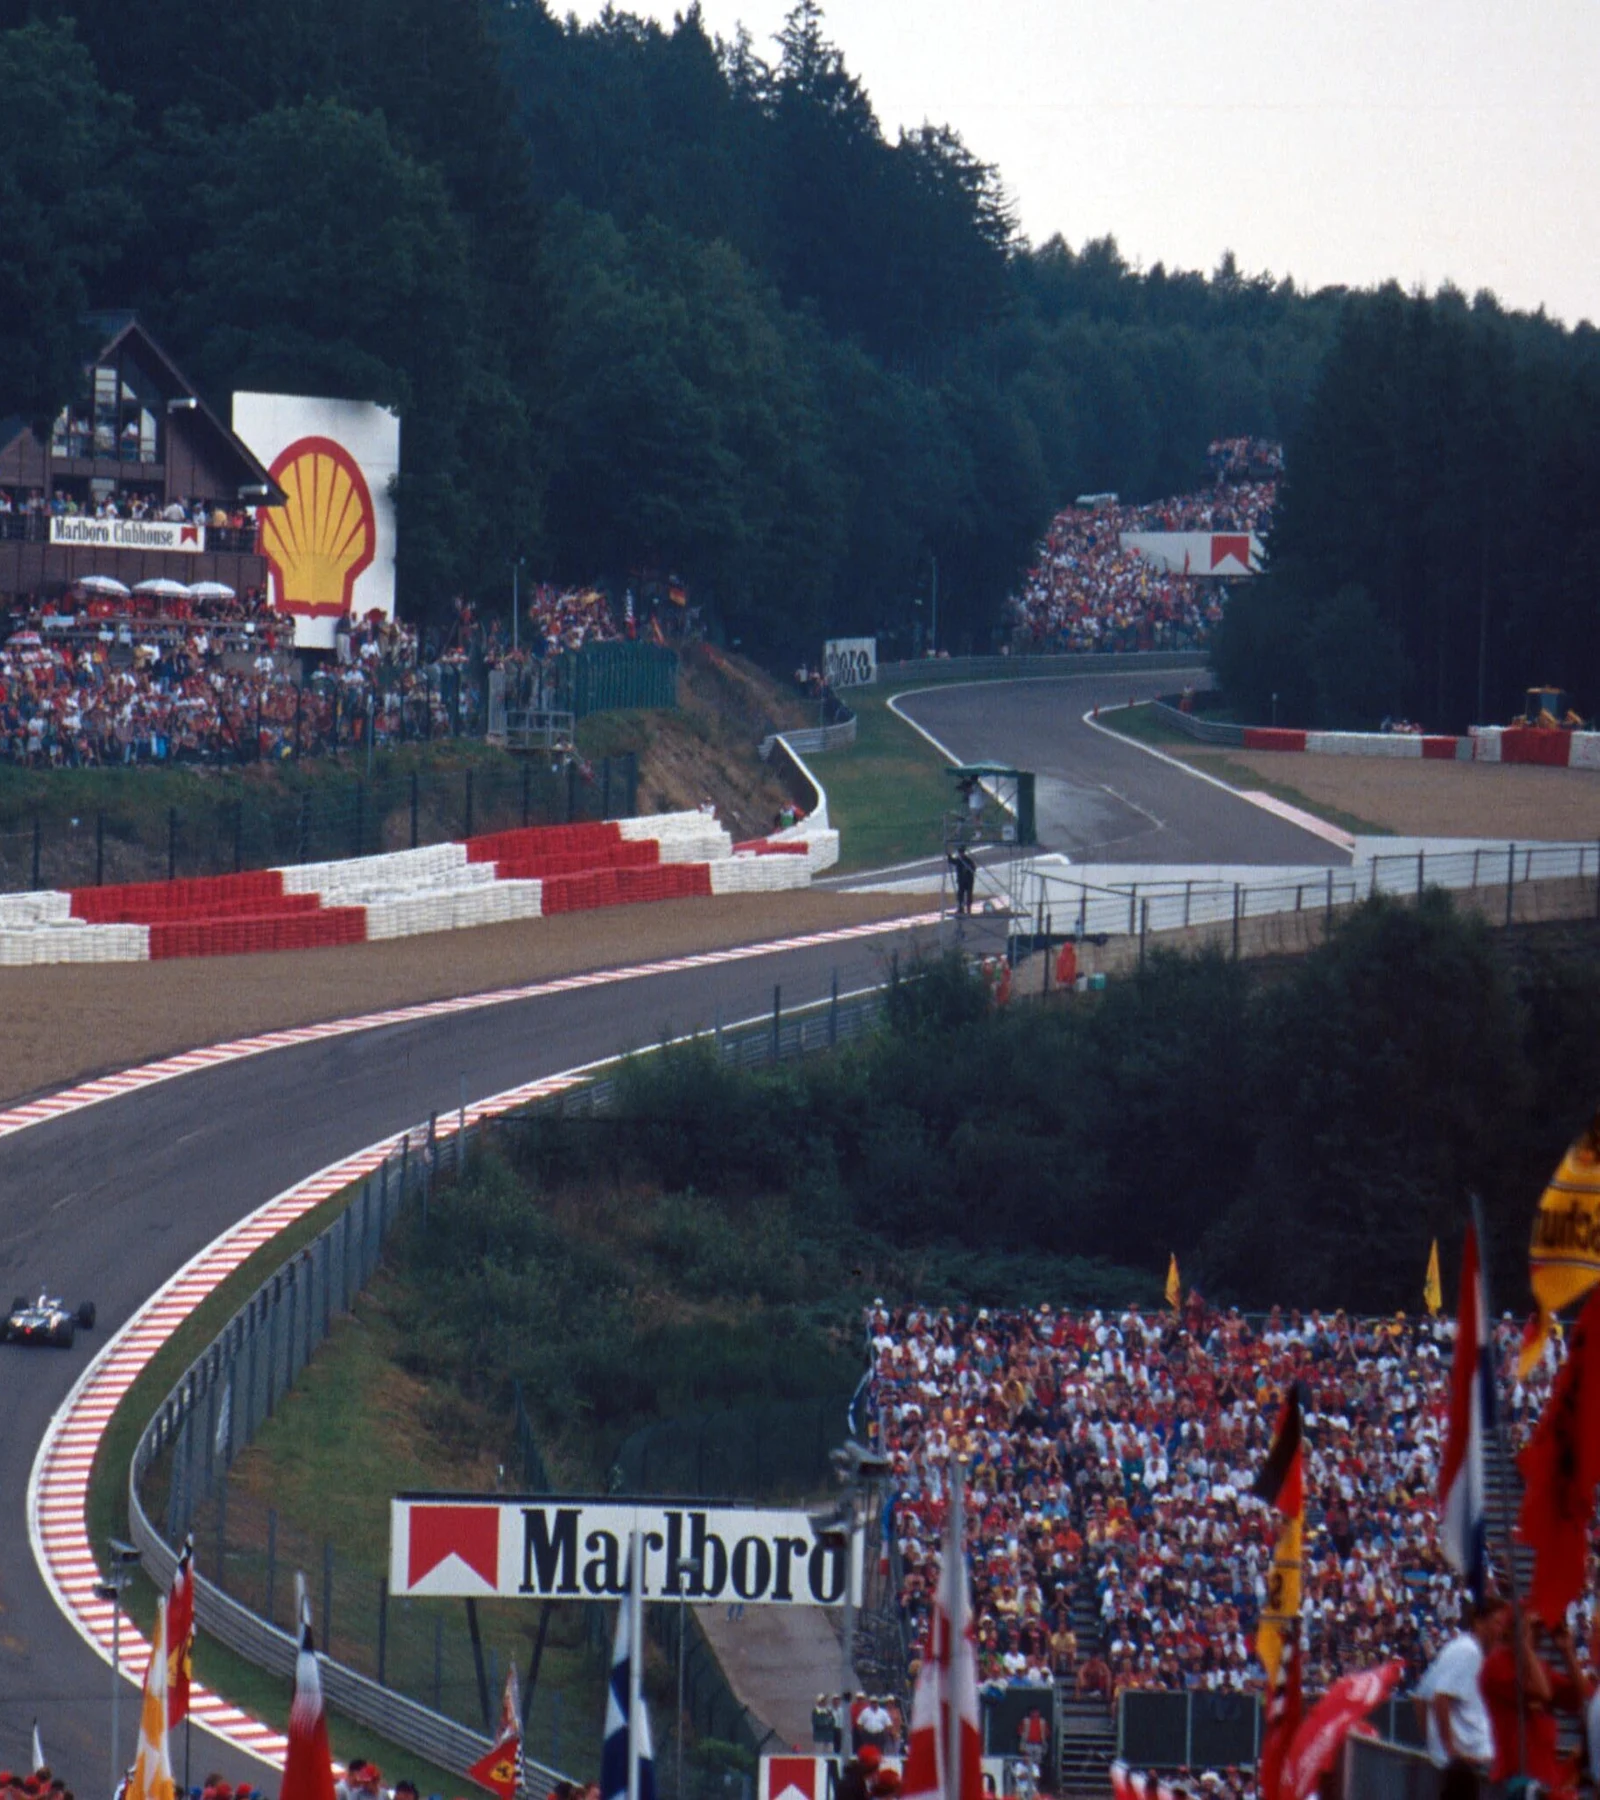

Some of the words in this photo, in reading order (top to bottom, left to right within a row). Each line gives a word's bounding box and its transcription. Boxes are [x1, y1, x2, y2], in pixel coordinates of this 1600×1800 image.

[55, 519, 109, 542] Marlboro
[113, 522, 174, 546] Clubhouse
[519, 1507, 848, 1603] Marlboro
